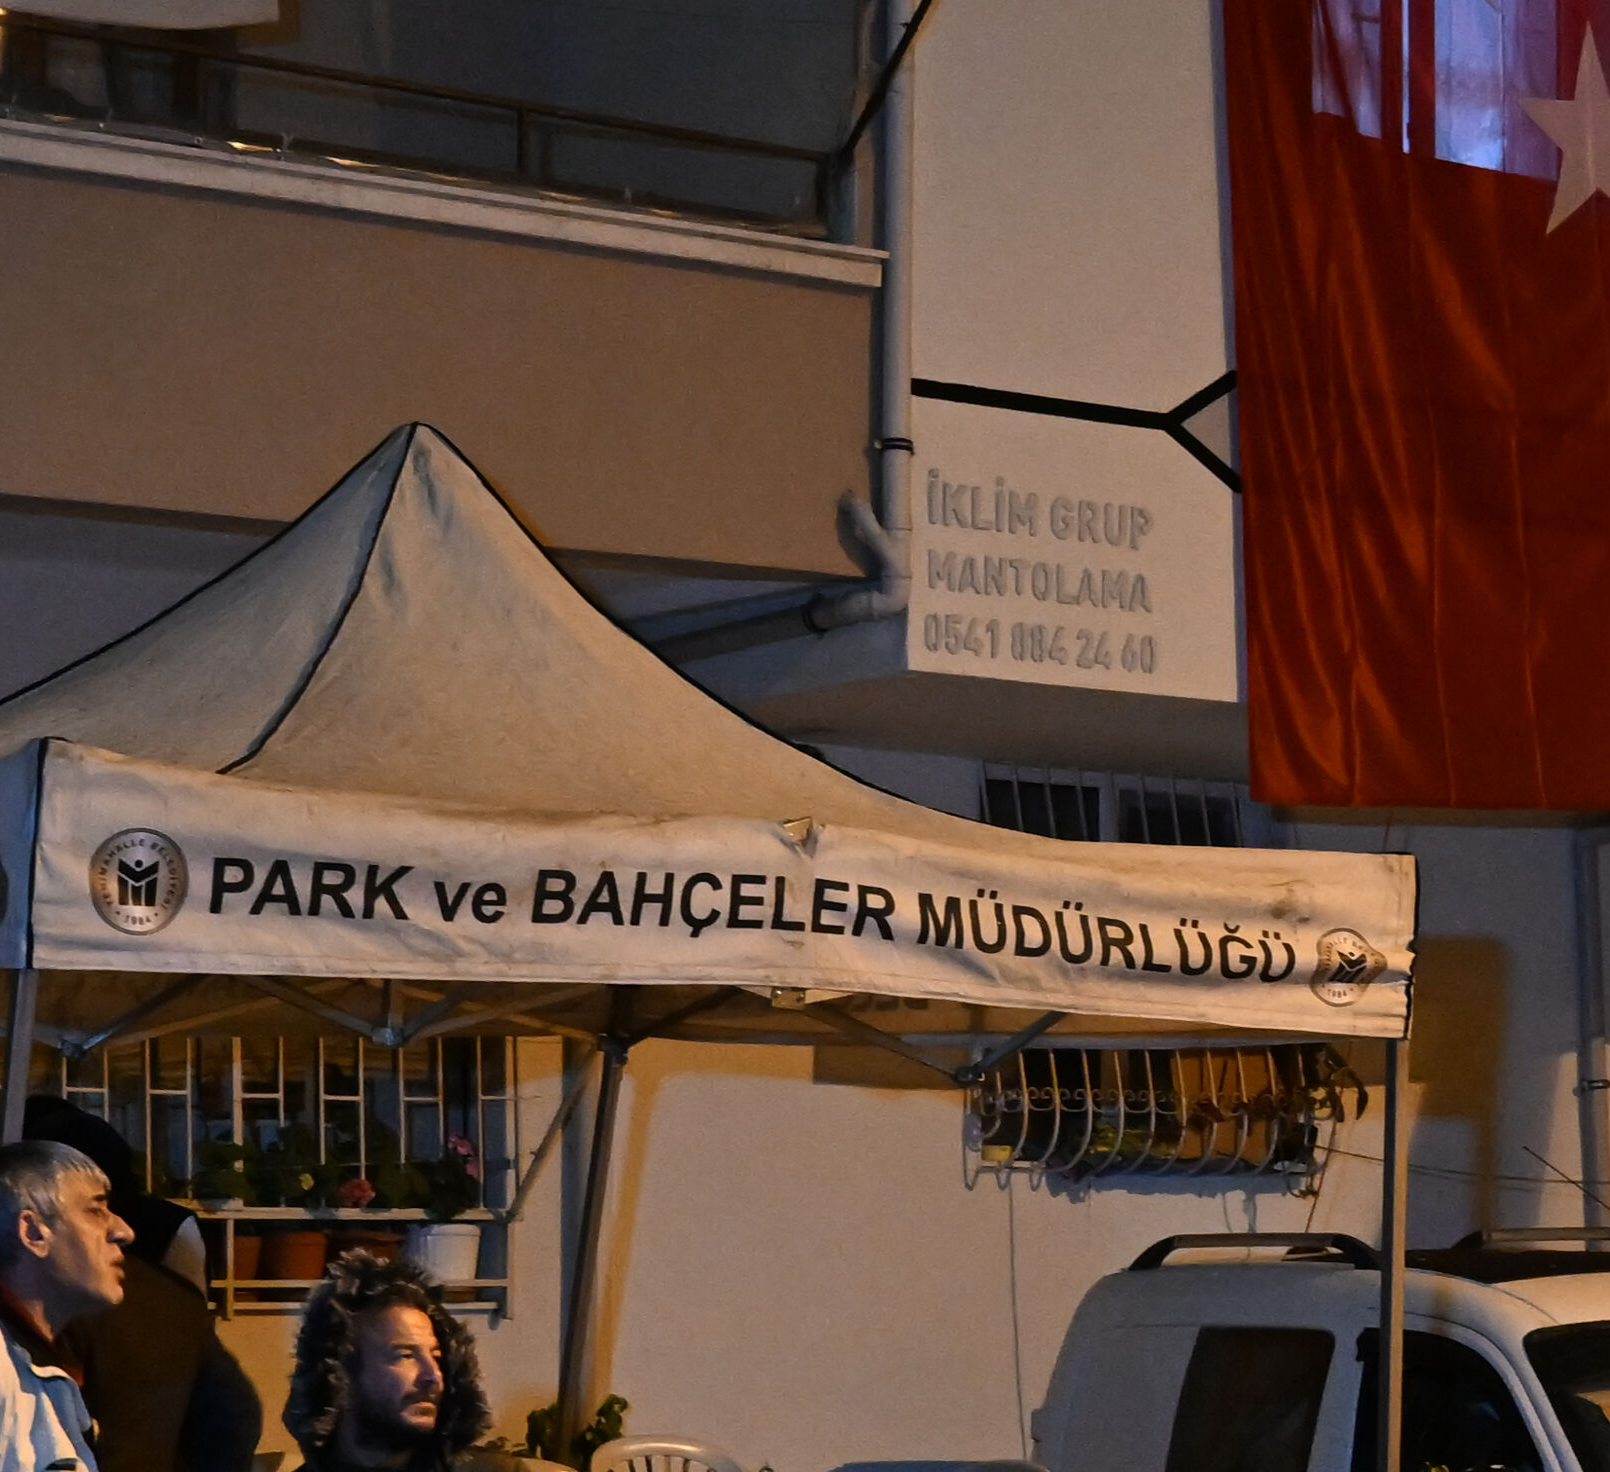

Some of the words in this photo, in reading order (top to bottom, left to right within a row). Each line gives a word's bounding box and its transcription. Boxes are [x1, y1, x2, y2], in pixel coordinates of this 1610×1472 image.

[926, 468, 1039, 537] İKLİM
[1049, 495, 1154, 551] GRUP
[927, 548, 1153, 614] MANTOLAMA
[924, 612, 1000, 659] 0541
[209, 857, 415, 922] PARK
[433, 881, 507, 924] ve
[531, 869, 896, 942] BAHÇELER
[916, 888, 1297, 984] MÜDÜRLÜĞÜ
